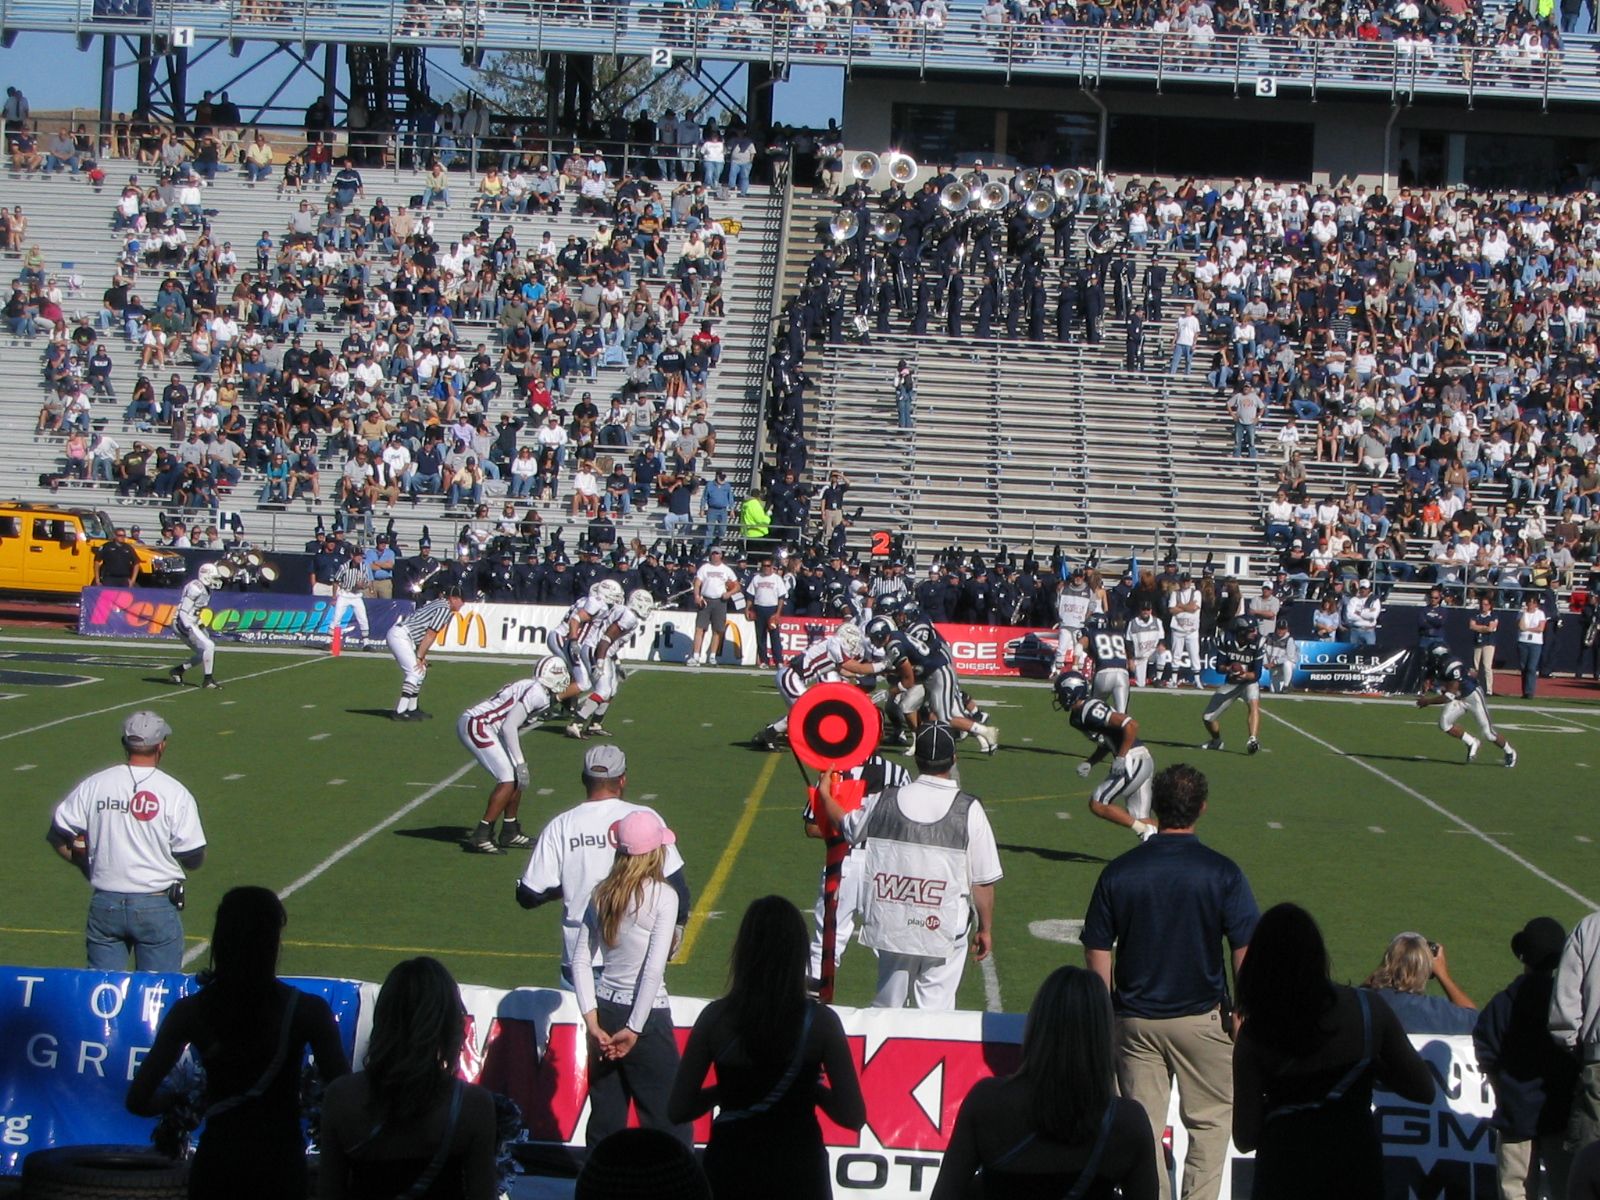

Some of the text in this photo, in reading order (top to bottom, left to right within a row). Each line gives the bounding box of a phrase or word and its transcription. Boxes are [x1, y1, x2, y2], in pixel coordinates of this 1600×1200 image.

[179, 29, 188, 44] 1
[655, 49, 668, 65] 2
[1260, 78, 1272, 94] 3
[220, 511, 237, 530] H
[872, 531, 889, 554] 2
[501, 617, 546, 644] i'm
[654, 624, 673, 649] it
[1095, 634, 1127, 660] 89
[956, 661, 1000, 670] DIESEL
[1300, 654, 1381, 666] ROGER
[1310, 673, 1332, 681] RENO
[1333, 673, 1352, 682] (775)
[570, 832, 607, 852] play
[873, 872, 947, 906] WAC
[90, 983, 169, 1022] OF
